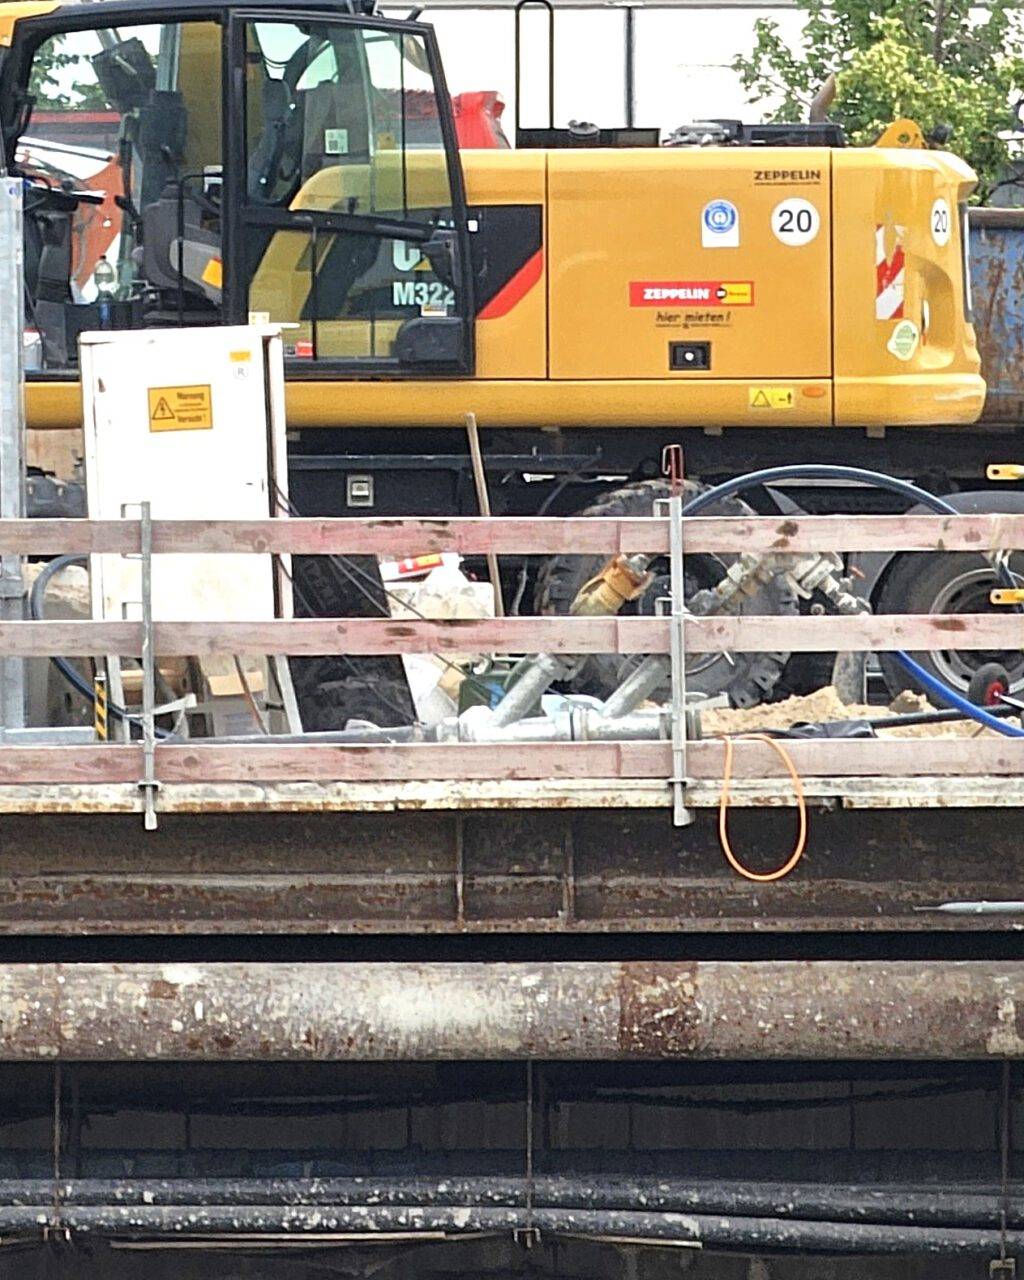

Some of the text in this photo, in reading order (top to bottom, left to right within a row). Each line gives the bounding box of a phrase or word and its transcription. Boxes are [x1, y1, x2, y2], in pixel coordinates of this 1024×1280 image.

[754, 170, 821, 181] ZEPPELIN
[778, 209, 812, 233] 20
[934, 210, 948, 233] 20
[643, 288, 710, 300] ZEPPELIN
[656, 311, 681, 322] hier
